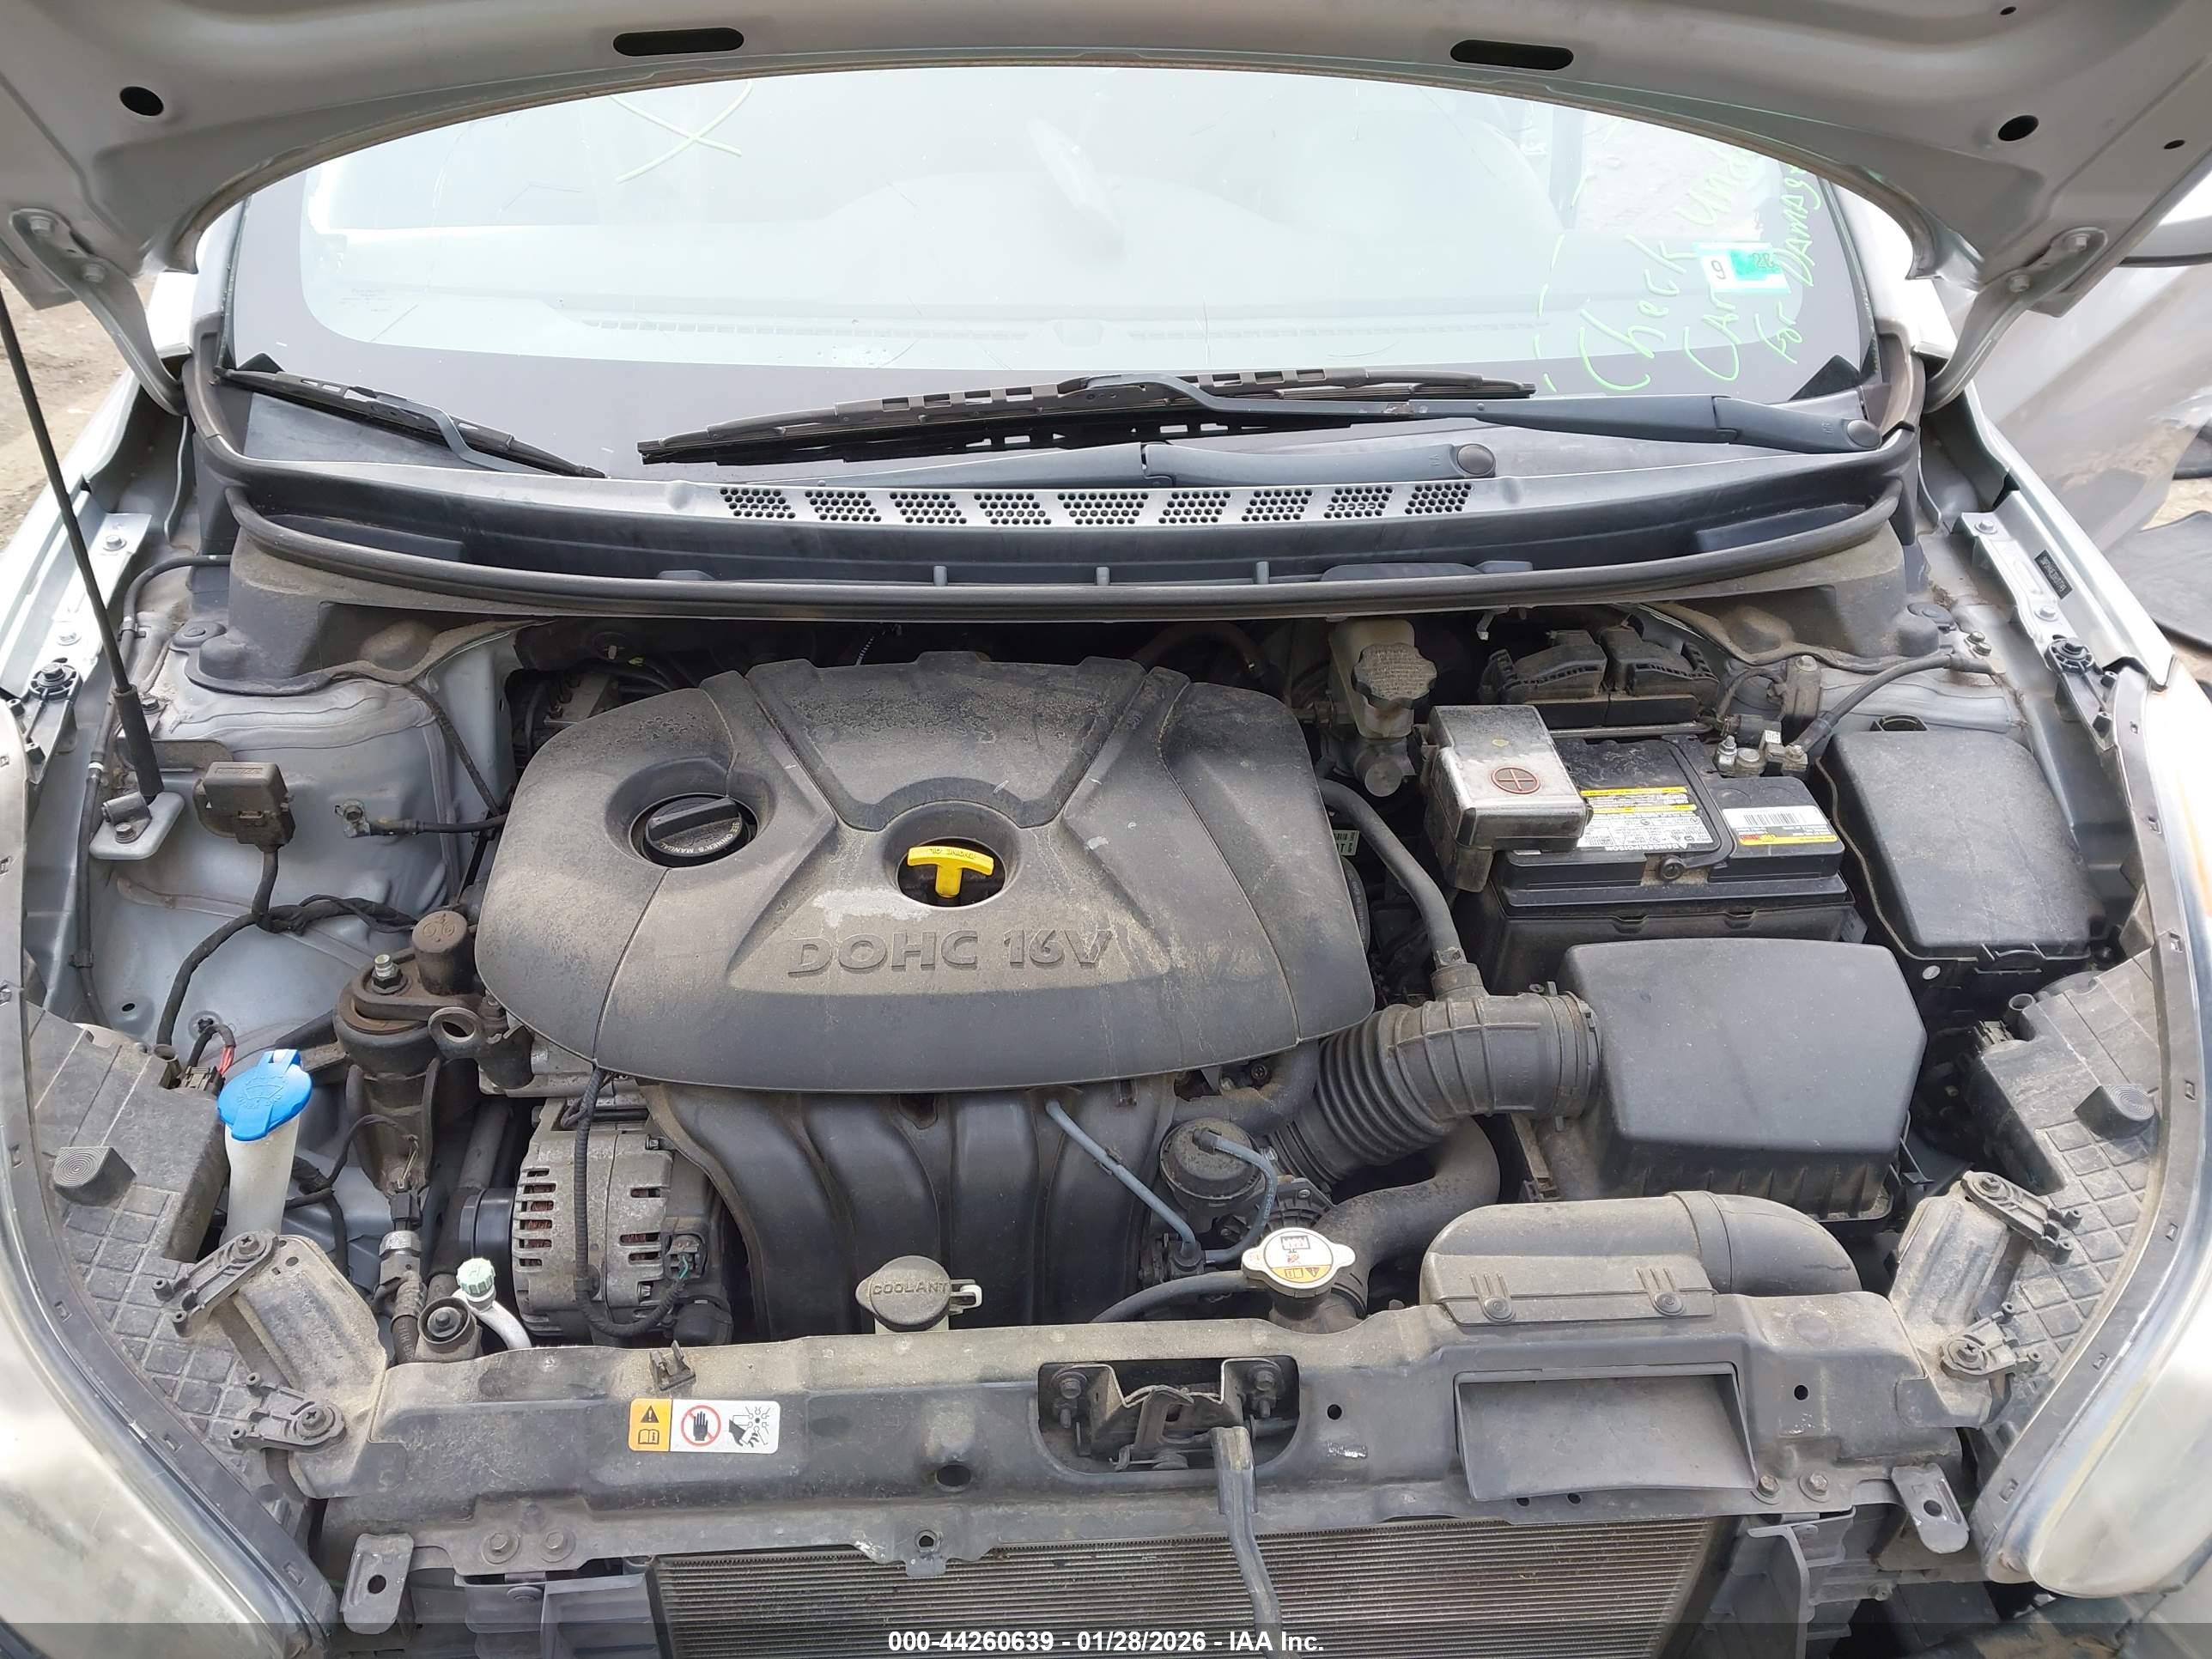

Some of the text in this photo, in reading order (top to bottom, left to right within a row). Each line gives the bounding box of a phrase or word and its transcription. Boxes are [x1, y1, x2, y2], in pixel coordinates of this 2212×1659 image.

[1711, 258, 1727, 280] 9
[659, 822, 740, 854] SEE OWNER'S MANUAL
[787, 928, 1114, 978] DOHC 16V
[872, 1282, 950, 1295] COOLANT
